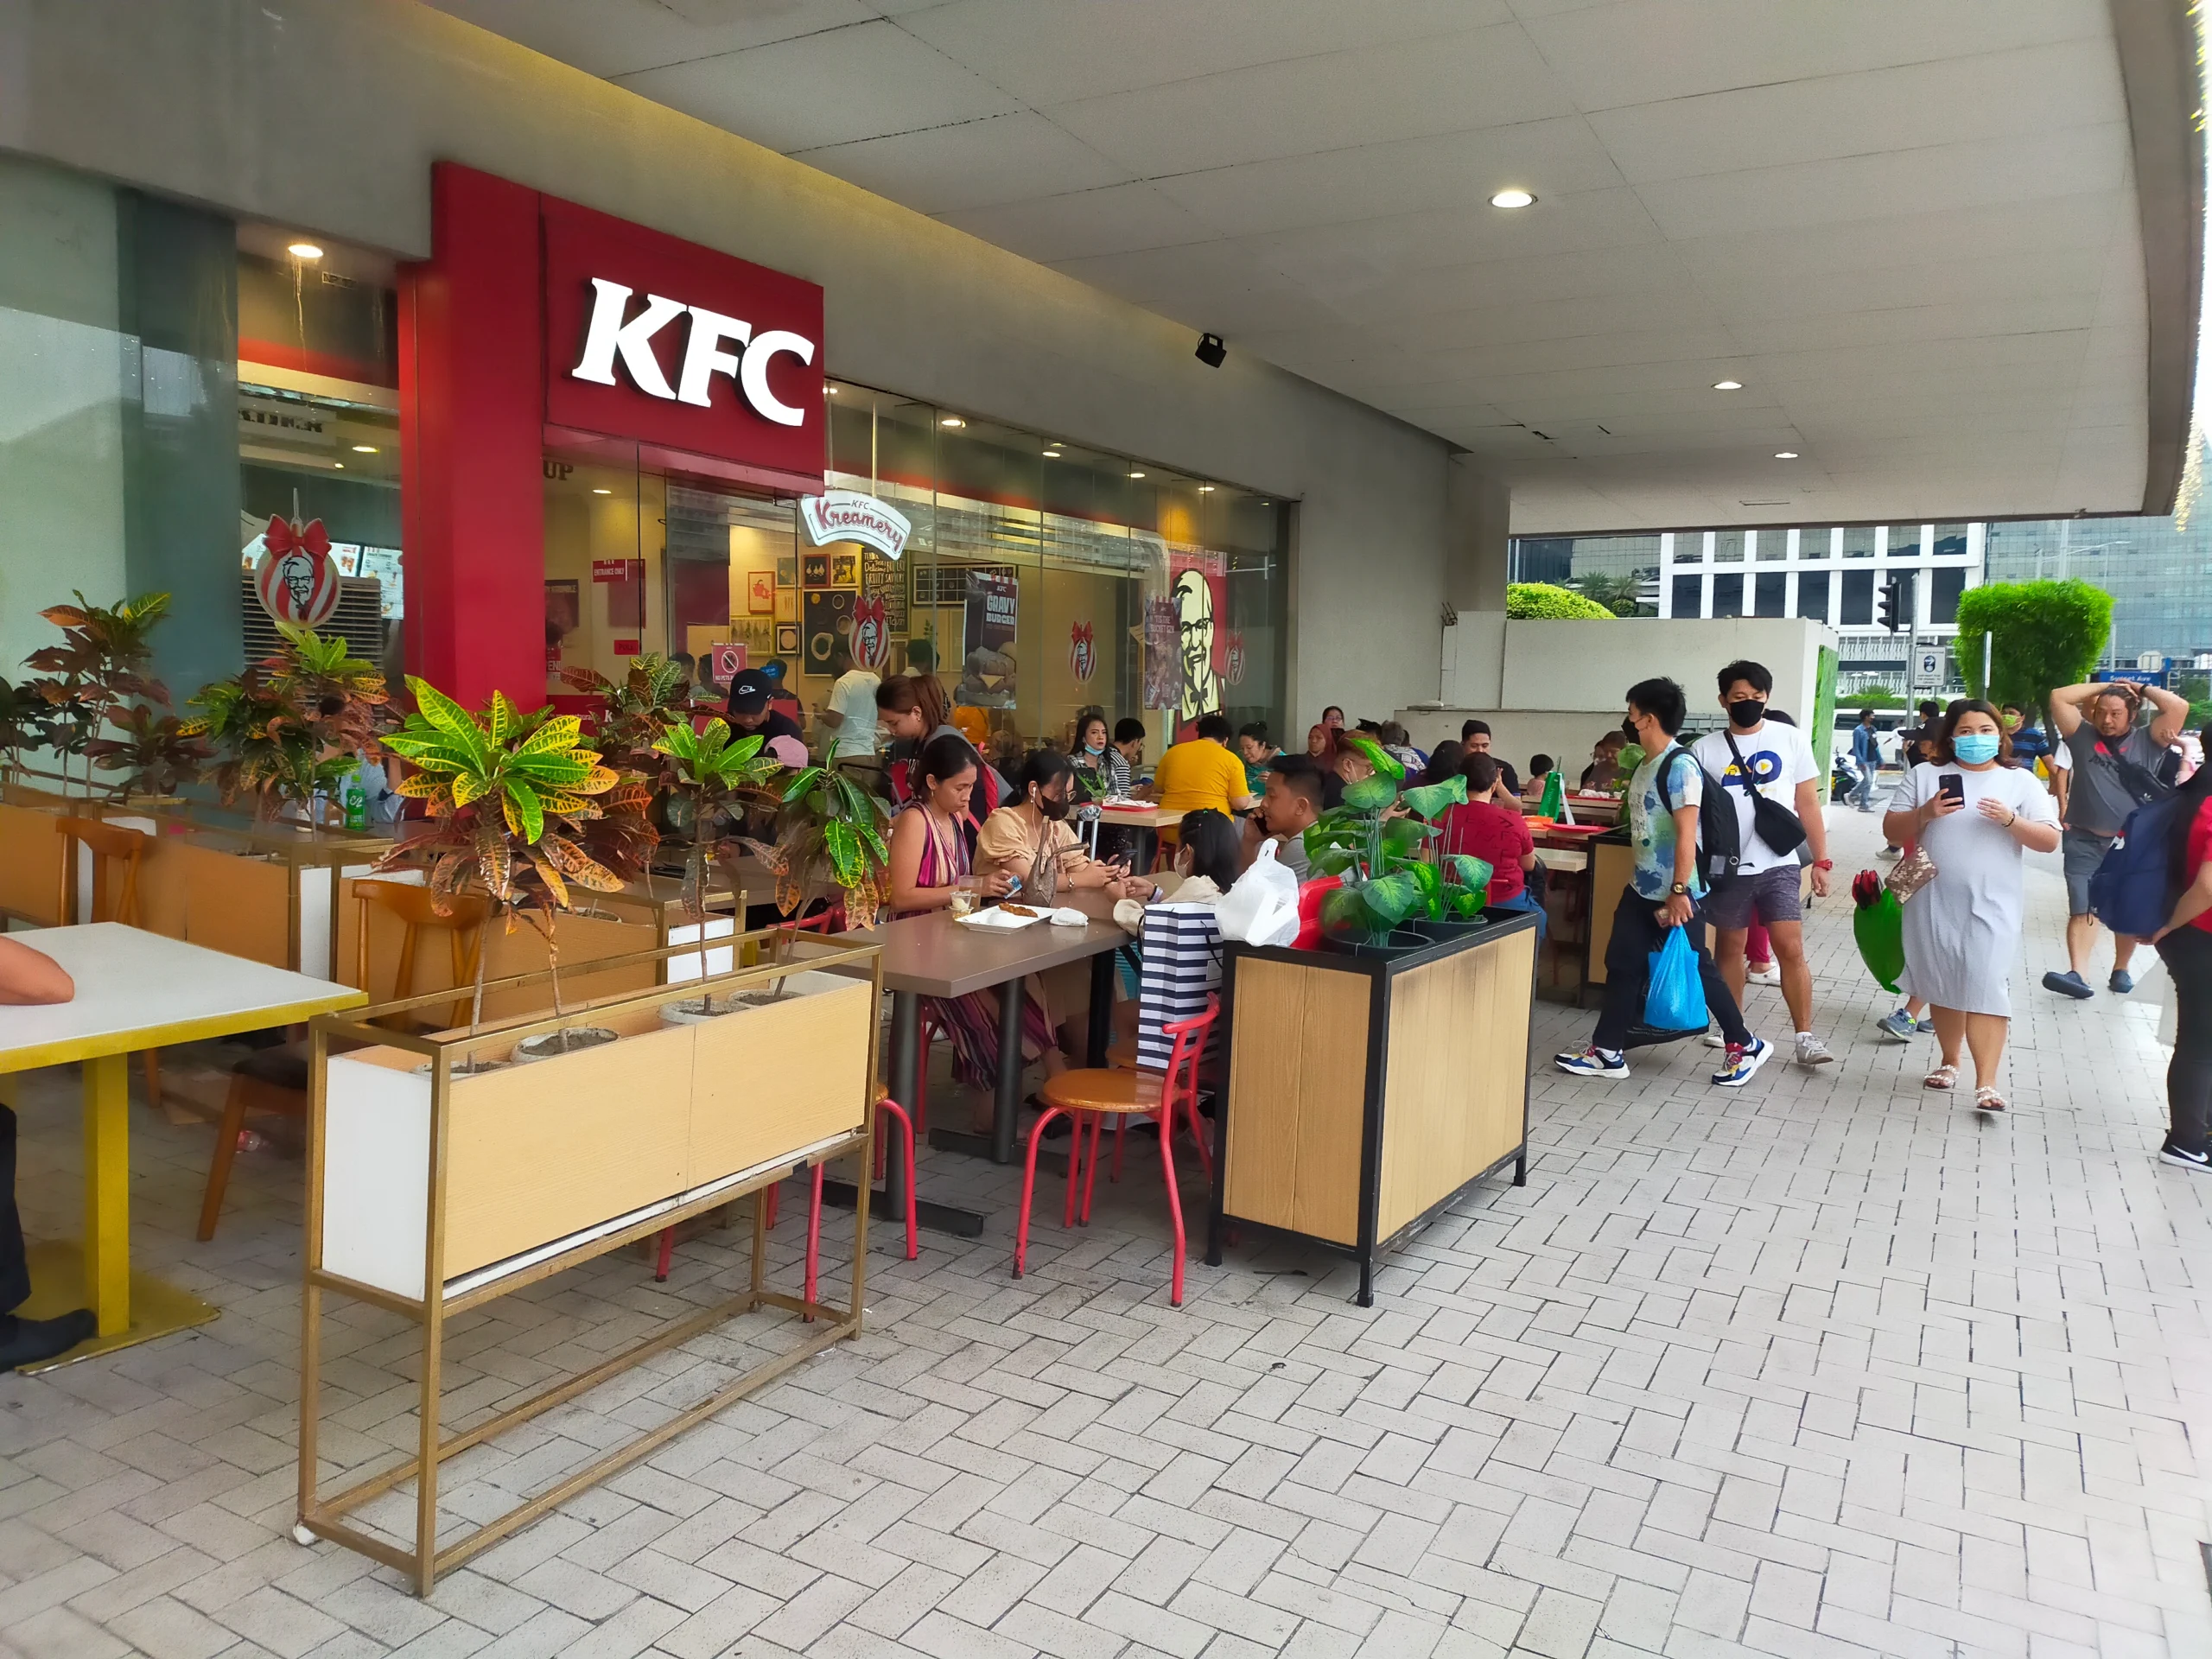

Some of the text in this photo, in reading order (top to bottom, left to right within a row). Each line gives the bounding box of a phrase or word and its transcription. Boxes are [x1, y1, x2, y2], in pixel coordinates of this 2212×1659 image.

[572, 277, 815, 427] KFC
[543, 460, 573, 480] UP
[850, 499, 869, 510] KFC
[814, 499, 904, 552] Kreamery
[987, 594, 1015, 614] GRAVY
[986, 612, 1015, 626] BURGER
